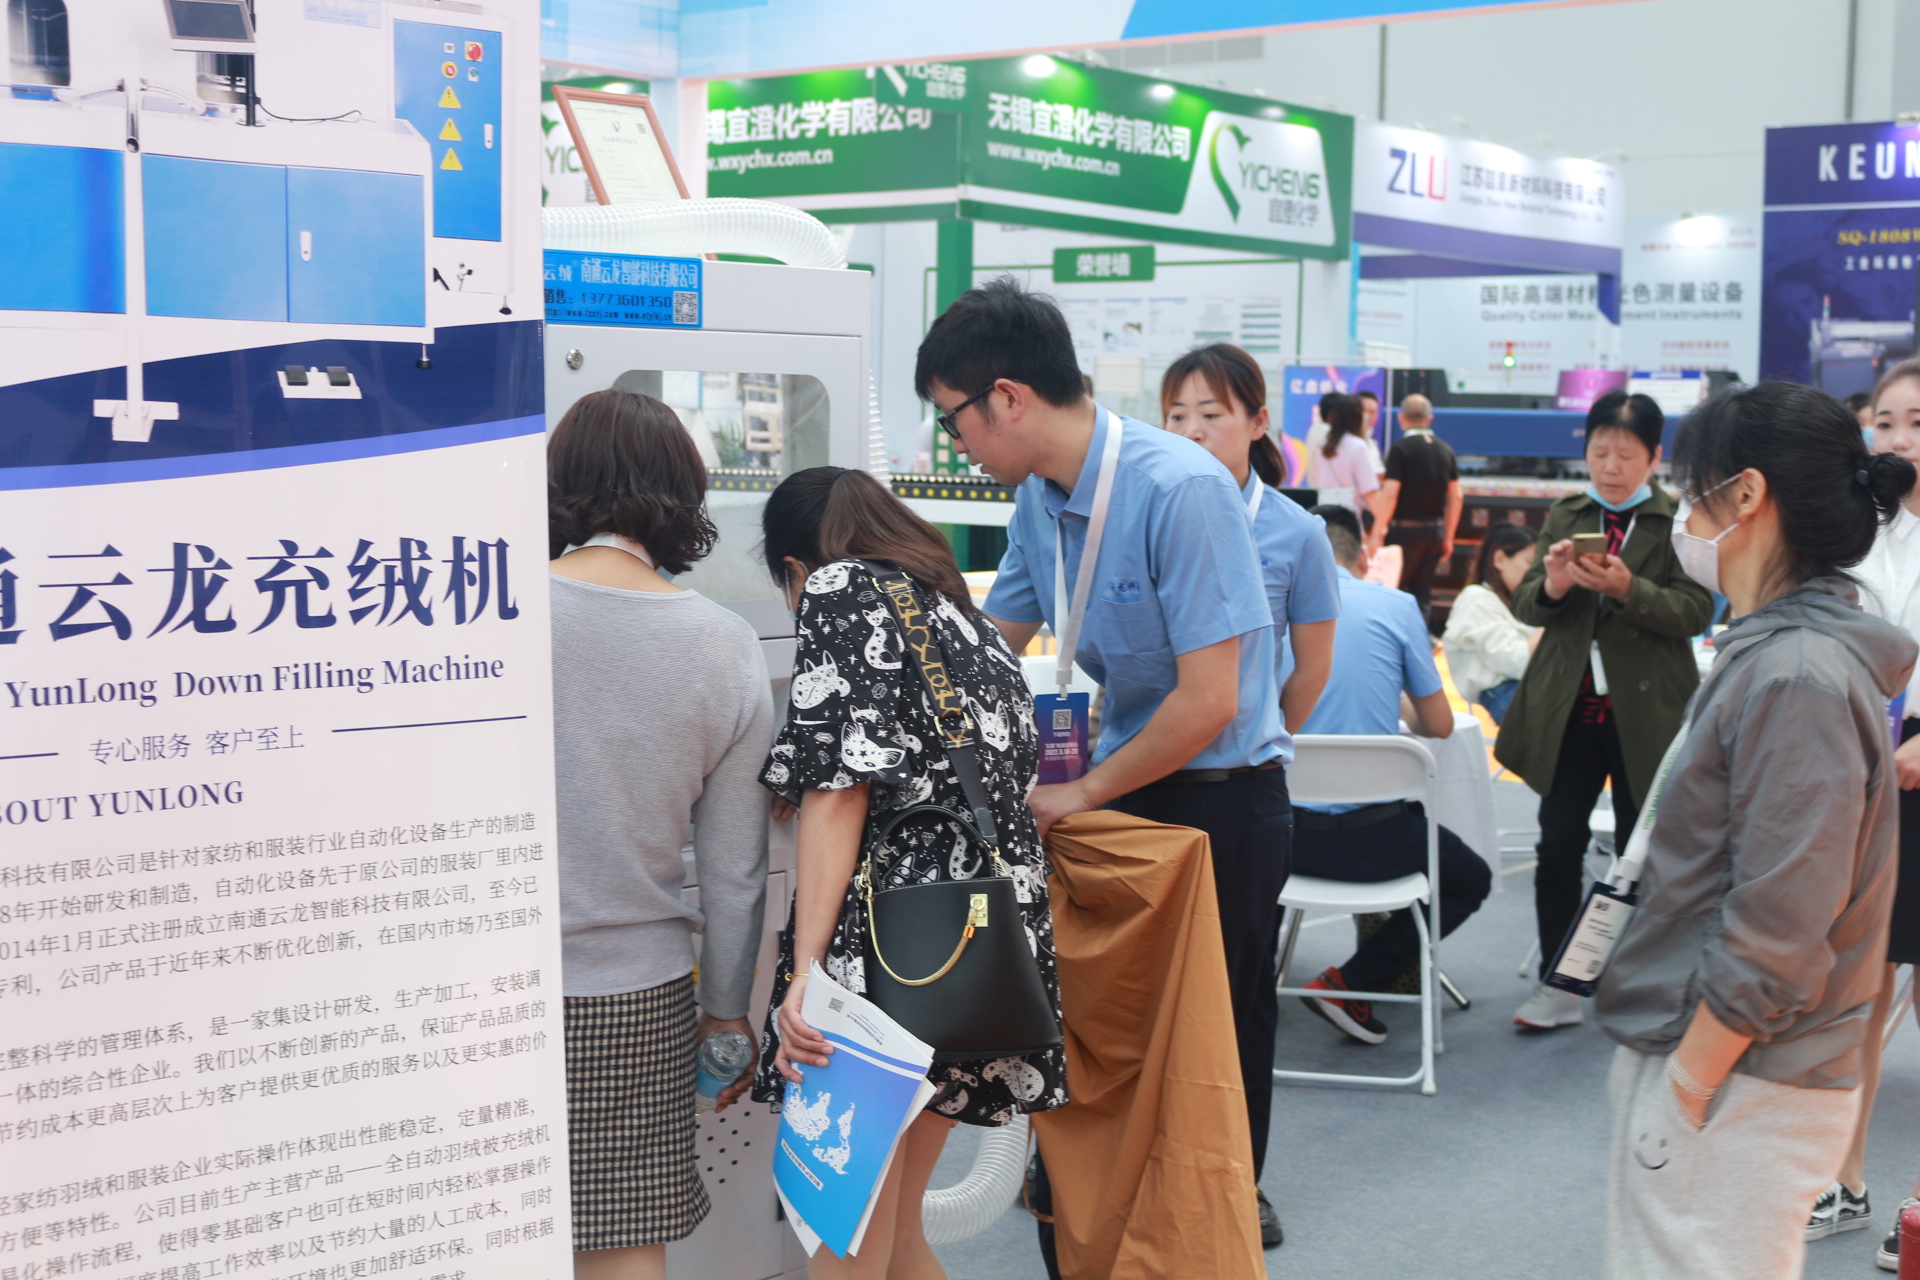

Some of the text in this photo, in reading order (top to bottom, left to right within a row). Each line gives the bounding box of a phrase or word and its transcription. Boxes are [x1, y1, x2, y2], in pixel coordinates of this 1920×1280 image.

[987, 92, 1192, 162] 无锡宜澄化学有限公司
[0, 536, 519, 644] 云龙充绒机
[5, 653, 504, 708] YunLong Down Filling Machine
[88, 725, 305, 764] 专心服务 客户至上
[0, 780, 244, 825] OUT YUNLONG
